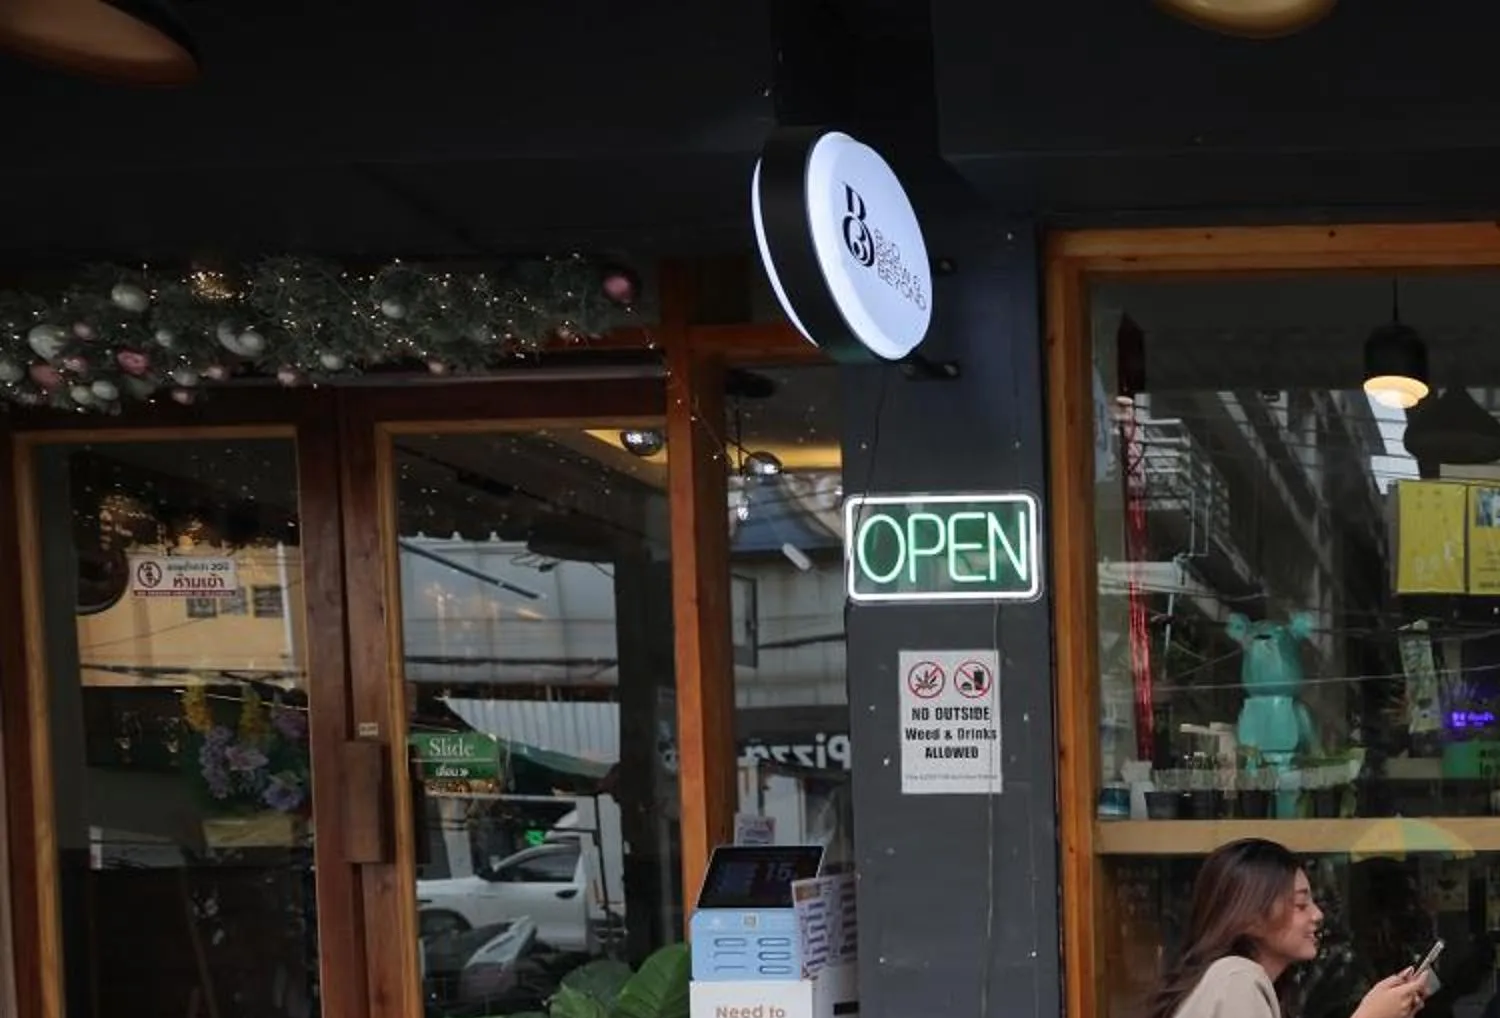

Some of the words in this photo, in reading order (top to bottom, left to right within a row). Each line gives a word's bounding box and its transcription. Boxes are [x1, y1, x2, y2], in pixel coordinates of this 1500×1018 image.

[857, 511, 1028, 583] OPEN
[173, 573, 225, 589] ห้ามเข้า
[912, 707, 930, 721] NO
[935, 707, 991, 721] OUTSIDE
[905, 727, 940, 741] Weed
[944, 730, 953, 741] &
[957, 727, 997, 741] Drinks
[429, 736, 475, 756] Slide
[925, 746, 979, 759] ALLOWED
[715, 1004, 764, 1018] Need
[768, 1006, 786, 1018] to
